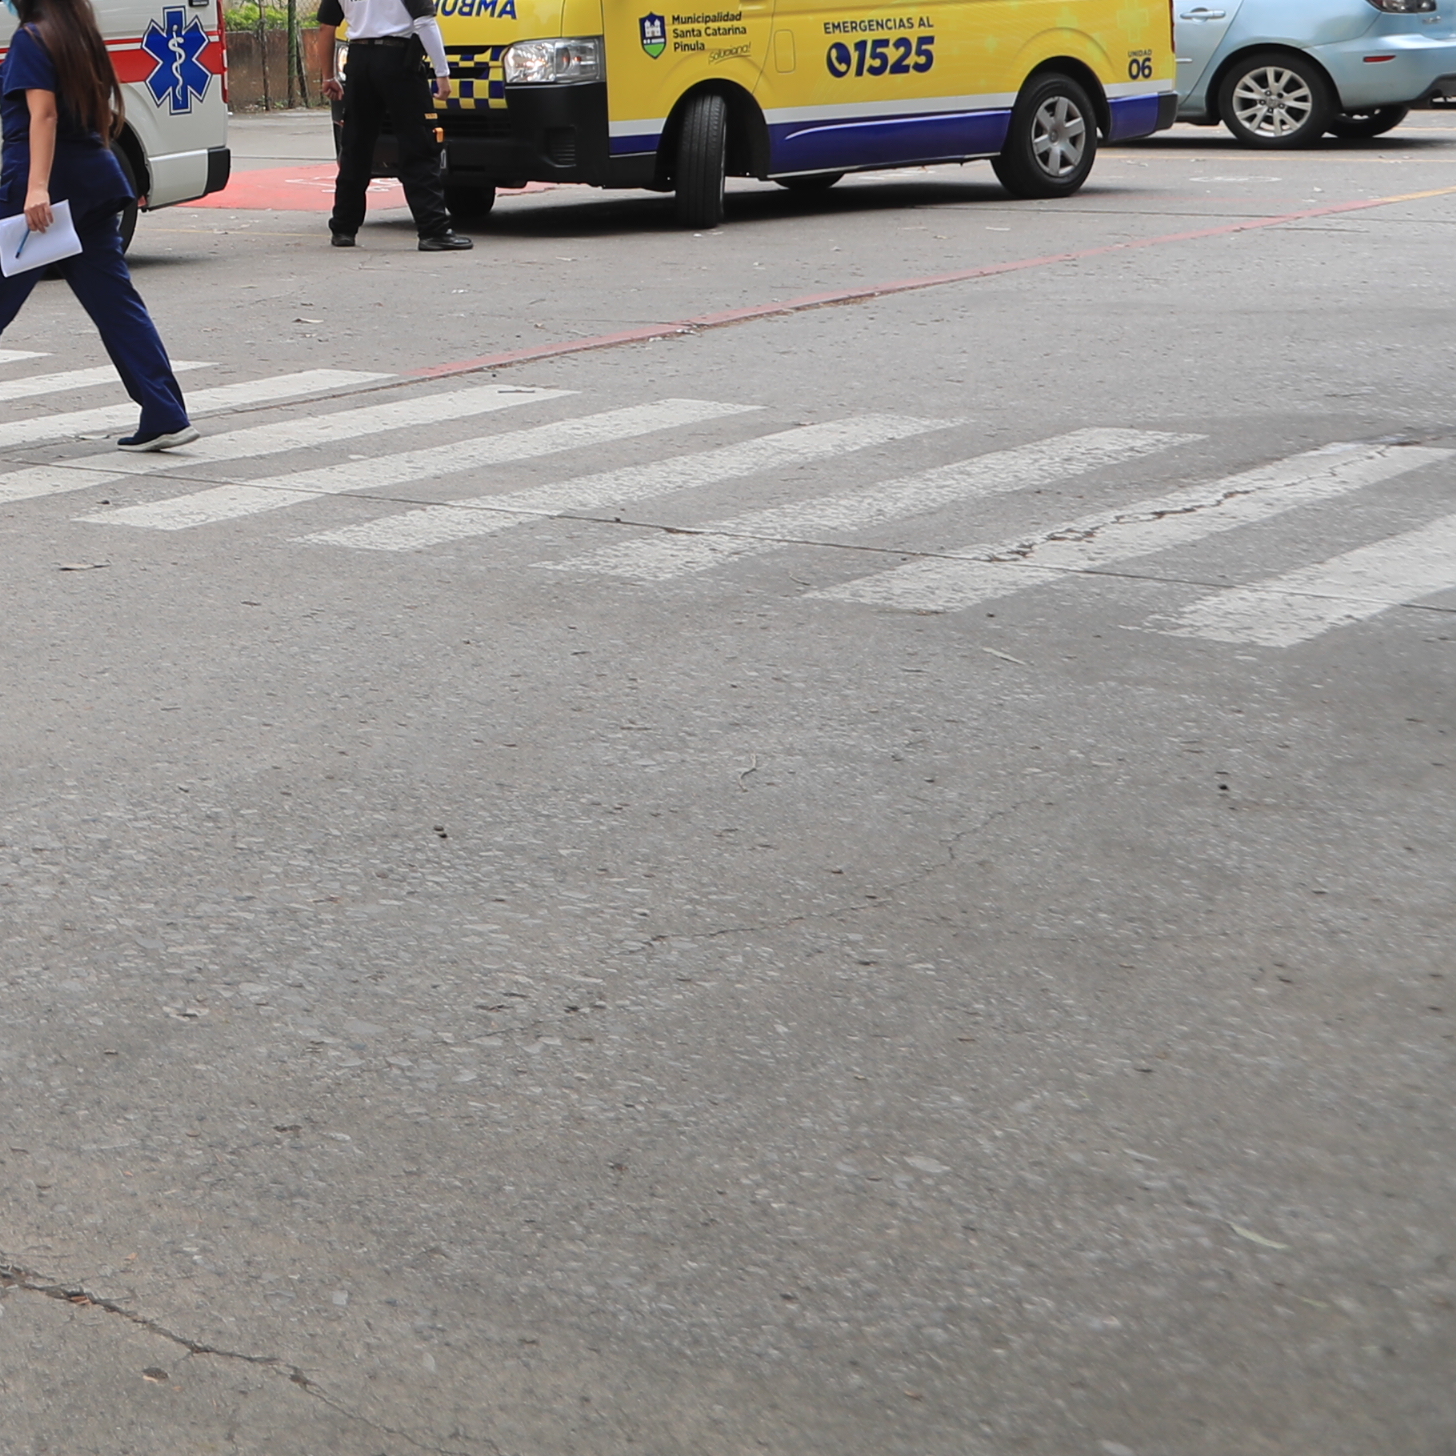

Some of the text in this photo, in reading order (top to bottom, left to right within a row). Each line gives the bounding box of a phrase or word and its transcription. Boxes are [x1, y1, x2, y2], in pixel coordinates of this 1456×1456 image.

[672, 10, 743, 25] Municipalidad
[823, 16, 934, 34] EMERGENCIAS AL
[673, 24, 747, 39] Santa Catarina
[674, 40, 705, 52] Pinula
[1128, 48, 1152, 57] UNIDAD
[854, 35, 936, 77] 1525
[1128, 57, 1152, 80] 06
